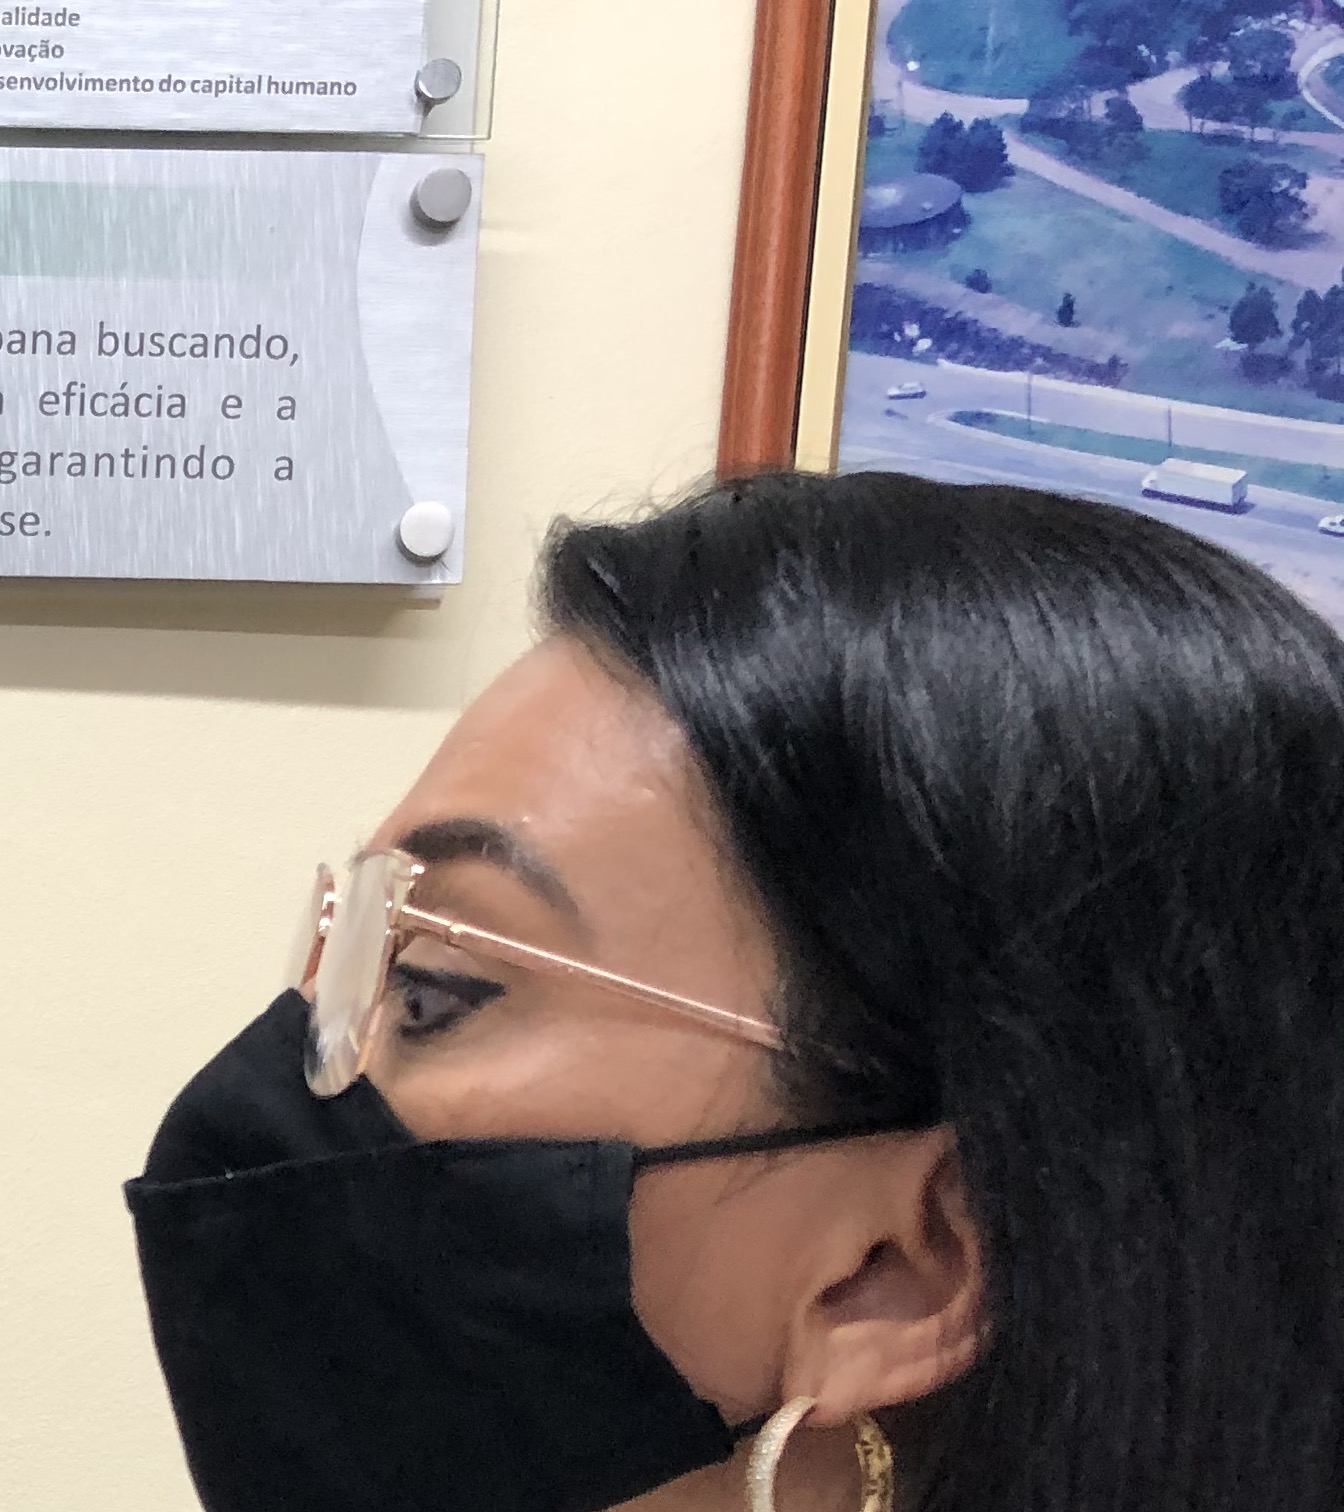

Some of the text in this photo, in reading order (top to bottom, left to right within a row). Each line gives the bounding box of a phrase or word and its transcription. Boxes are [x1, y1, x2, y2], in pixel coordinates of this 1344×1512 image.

[158, 75, 186, 94] do
[190, 74, 262, 98] capital
[267, 75, 358, 97] humano
[97, 321, 299, 367] buscando,
[38, 381, 187, 419] eficácia
[220, 394, 243, 420] e
[276, 394, 297, 422] a
[273, 454, 294, 481] a
